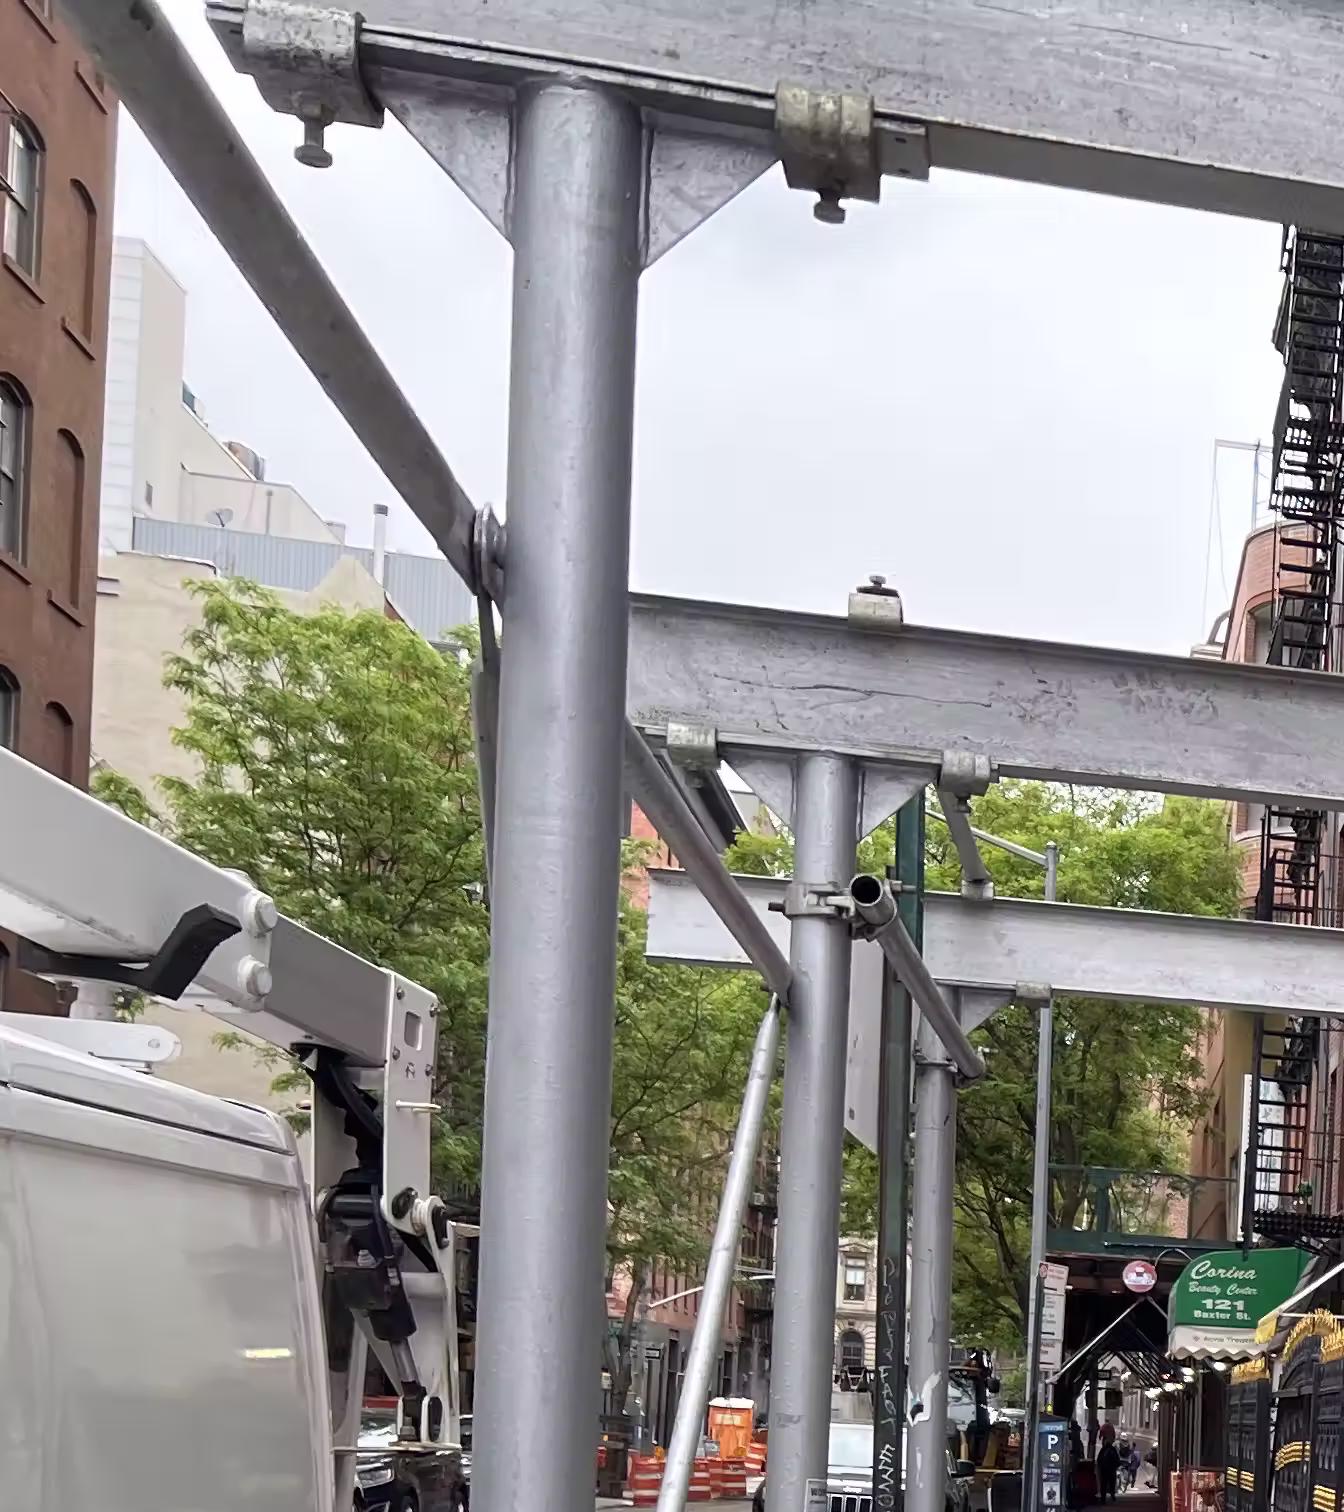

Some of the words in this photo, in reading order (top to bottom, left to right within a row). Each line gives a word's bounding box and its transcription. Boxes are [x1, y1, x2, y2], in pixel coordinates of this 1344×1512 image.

[1191, 1260, 1257, 1279] Corina
[1189, 1281, 1221, 1296] Beauty
[1202, 1299, 1244, 1310] 121
[1194, 1310, 1231, 1319] Baxter
[1048, 1434, 1058, 1449] P
